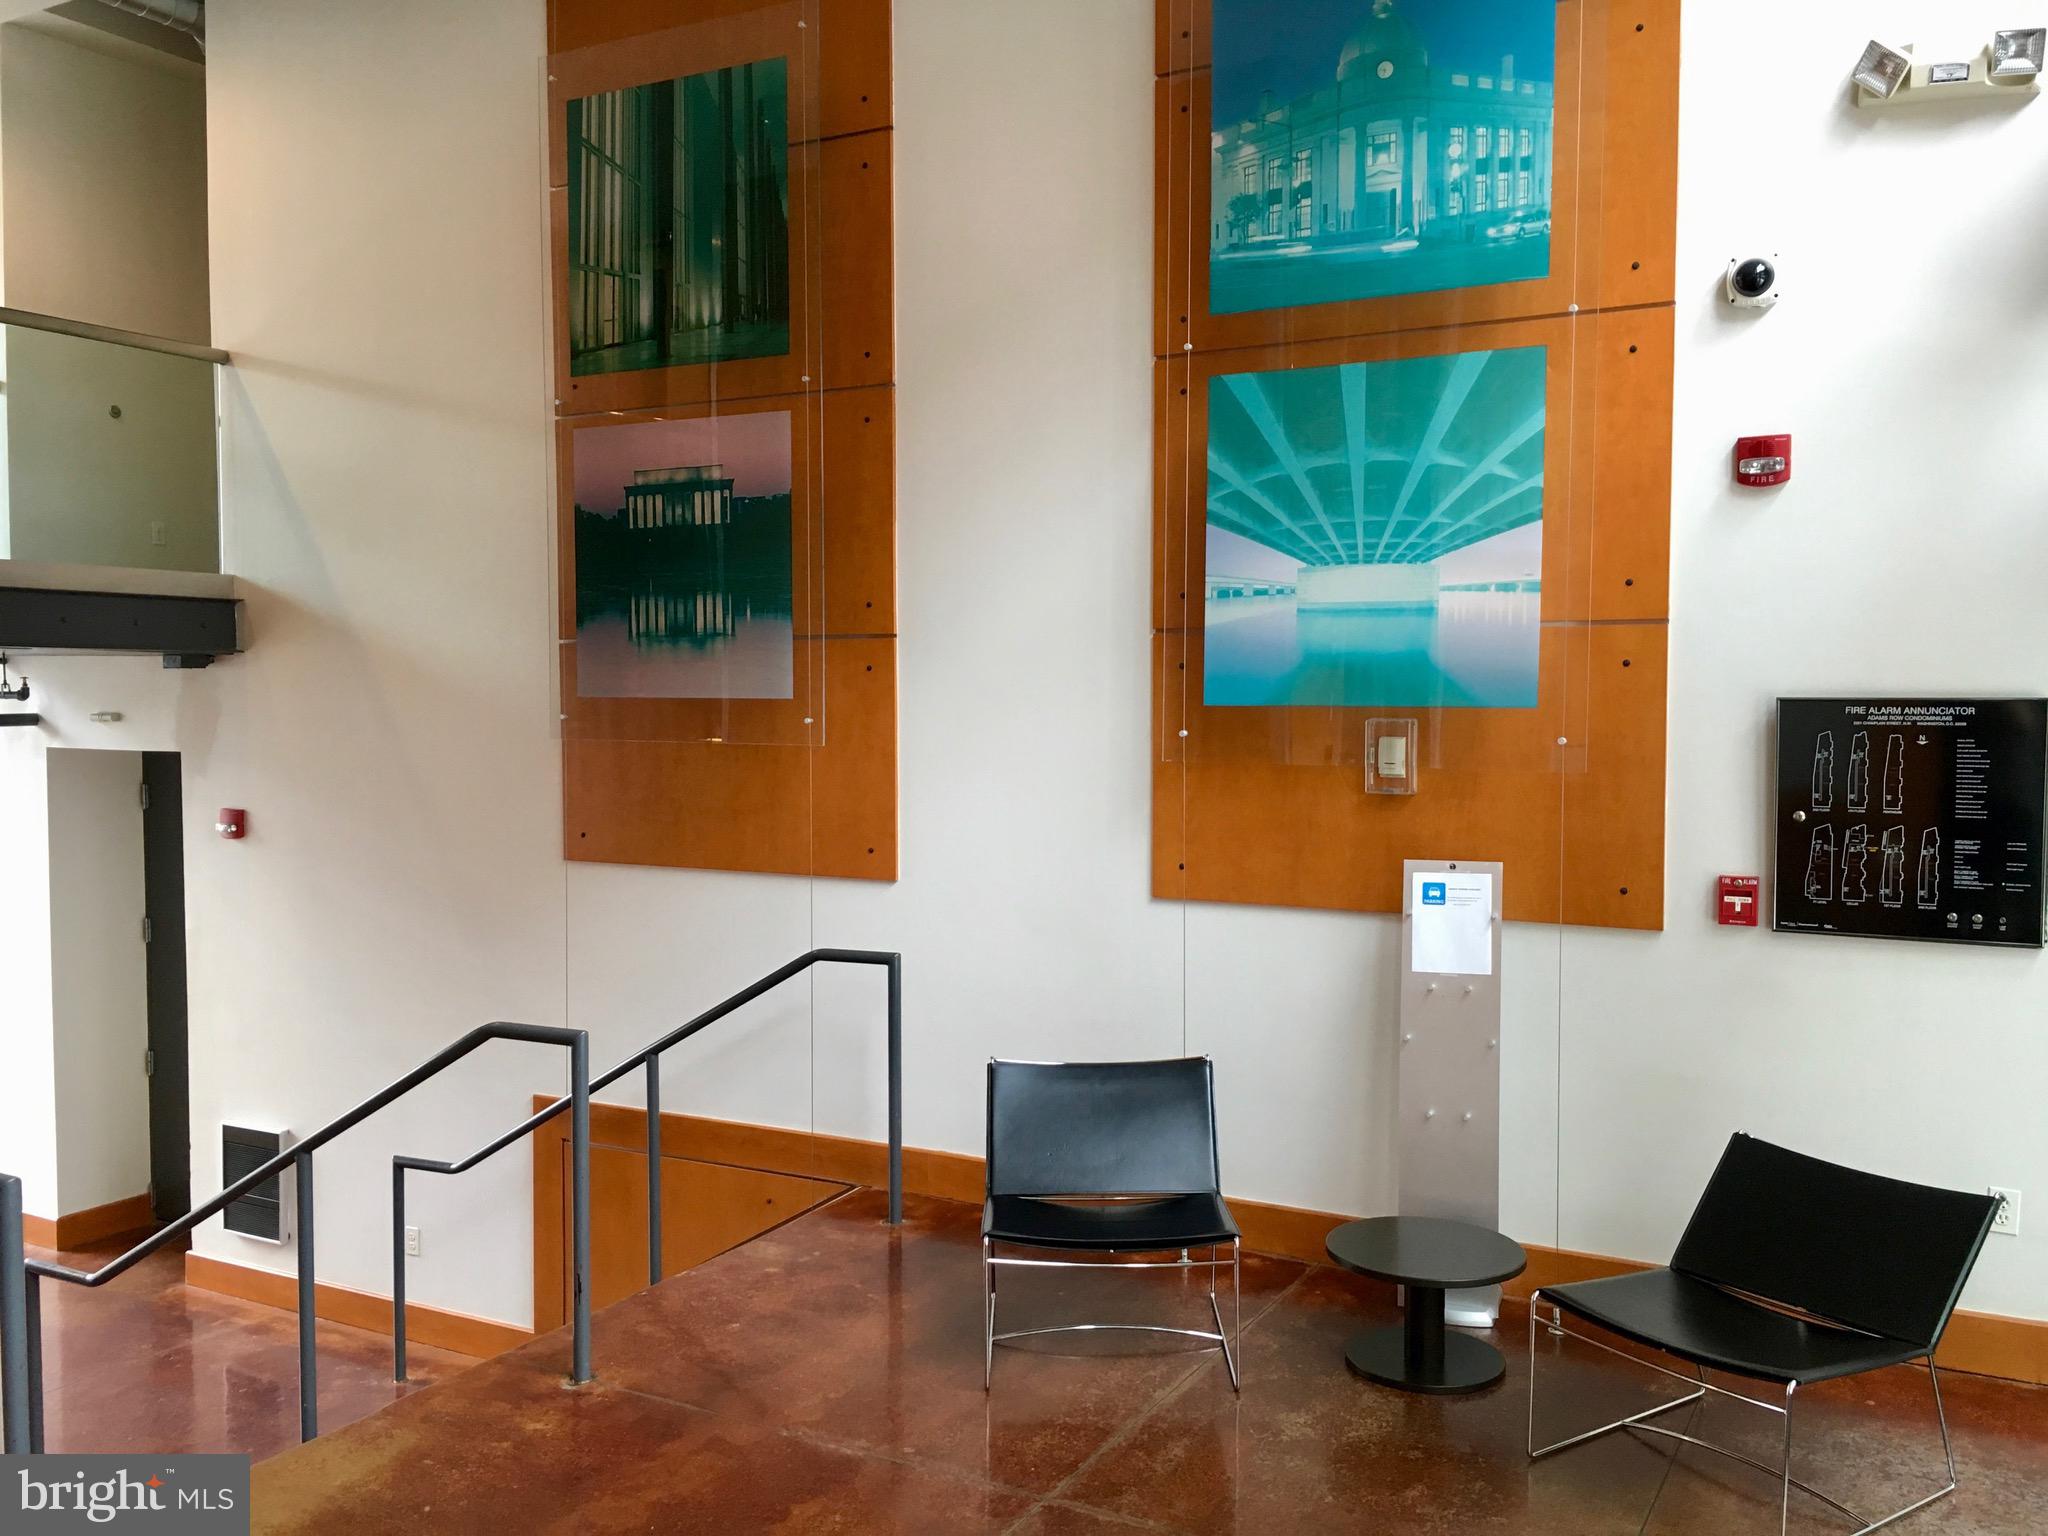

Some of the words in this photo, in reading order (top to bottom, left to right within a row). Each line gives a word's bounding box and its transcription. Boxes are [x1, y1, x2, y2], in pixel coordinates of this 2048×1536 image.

[1750, 475, 1775, 483] FIRE
[1845, 706, 1866, 715] FIRE
[1868, 706, 1901, 715] ALARM
[1903, 706, 1976, 715] ANNUNCIATOR
